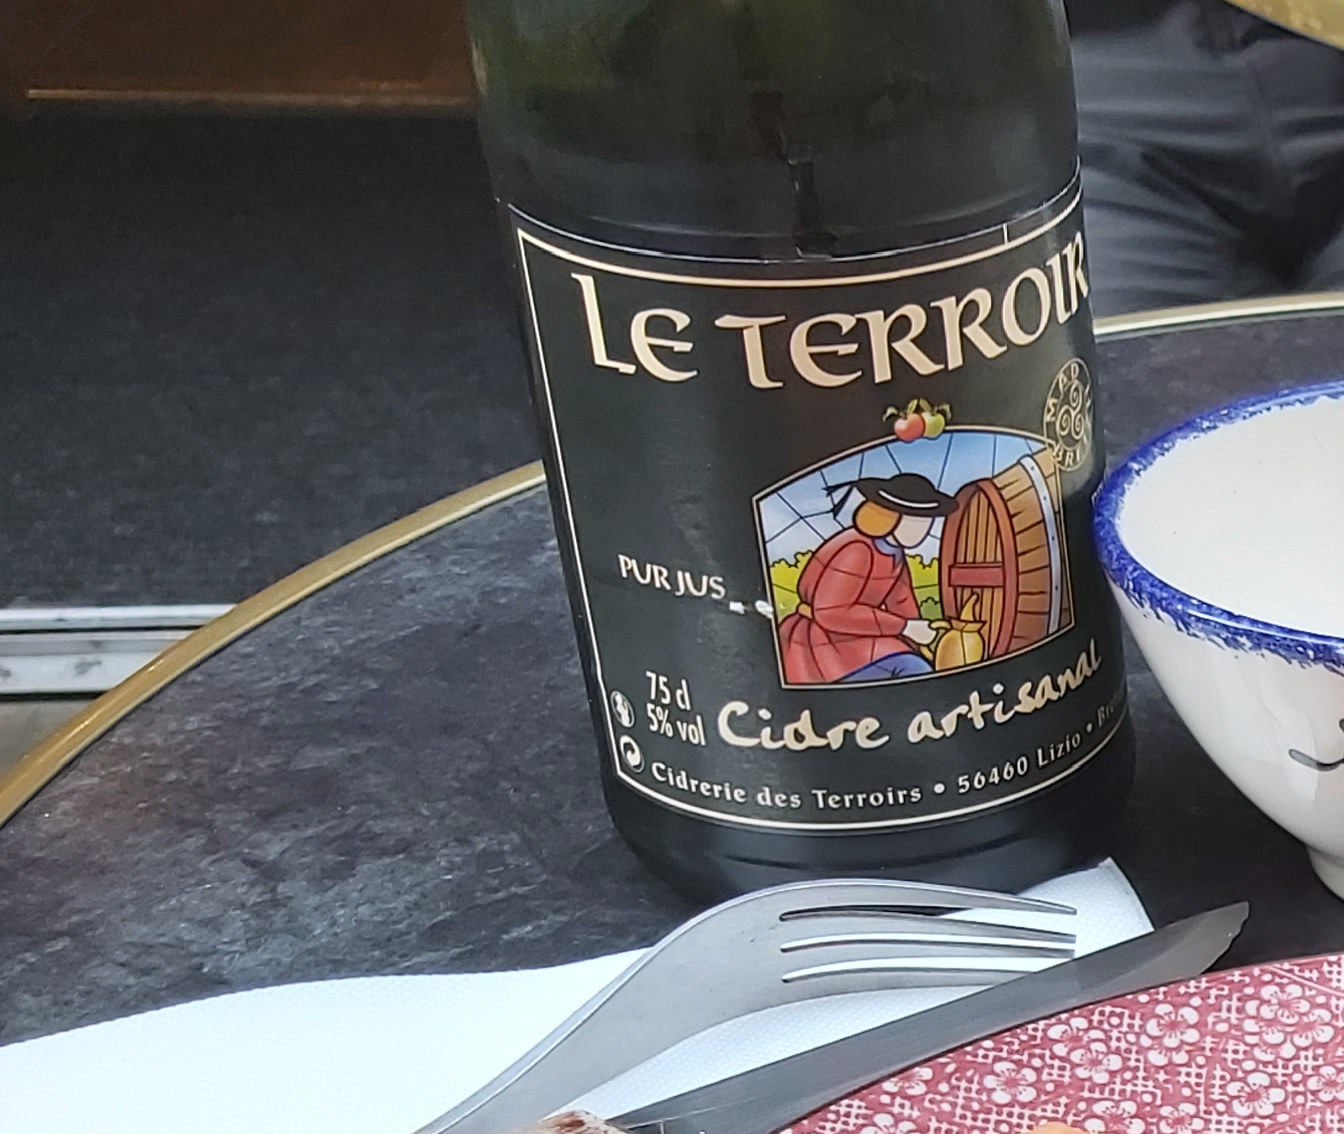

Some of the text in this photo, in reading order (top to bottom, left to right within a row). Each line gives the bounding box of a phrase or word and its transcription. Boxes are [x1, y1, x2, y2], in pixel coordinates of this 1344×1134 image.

[571, 272, 698, 382] LE
[617, 553, 726, 600] PUR JUS
[645, 670, 671, 705] 75
[717, 637, 1102, 751] Cidre artisanal
[646, 702, 706, 746] 5% vol
[651, 761, 748, 803] Cidrerie
[757, 786, 802, 809] des
[811, 786, 922, 809] Terroirs
[957, 756, 1029, 794] 56460
[1036, 732, 1081, 768] Lizio
